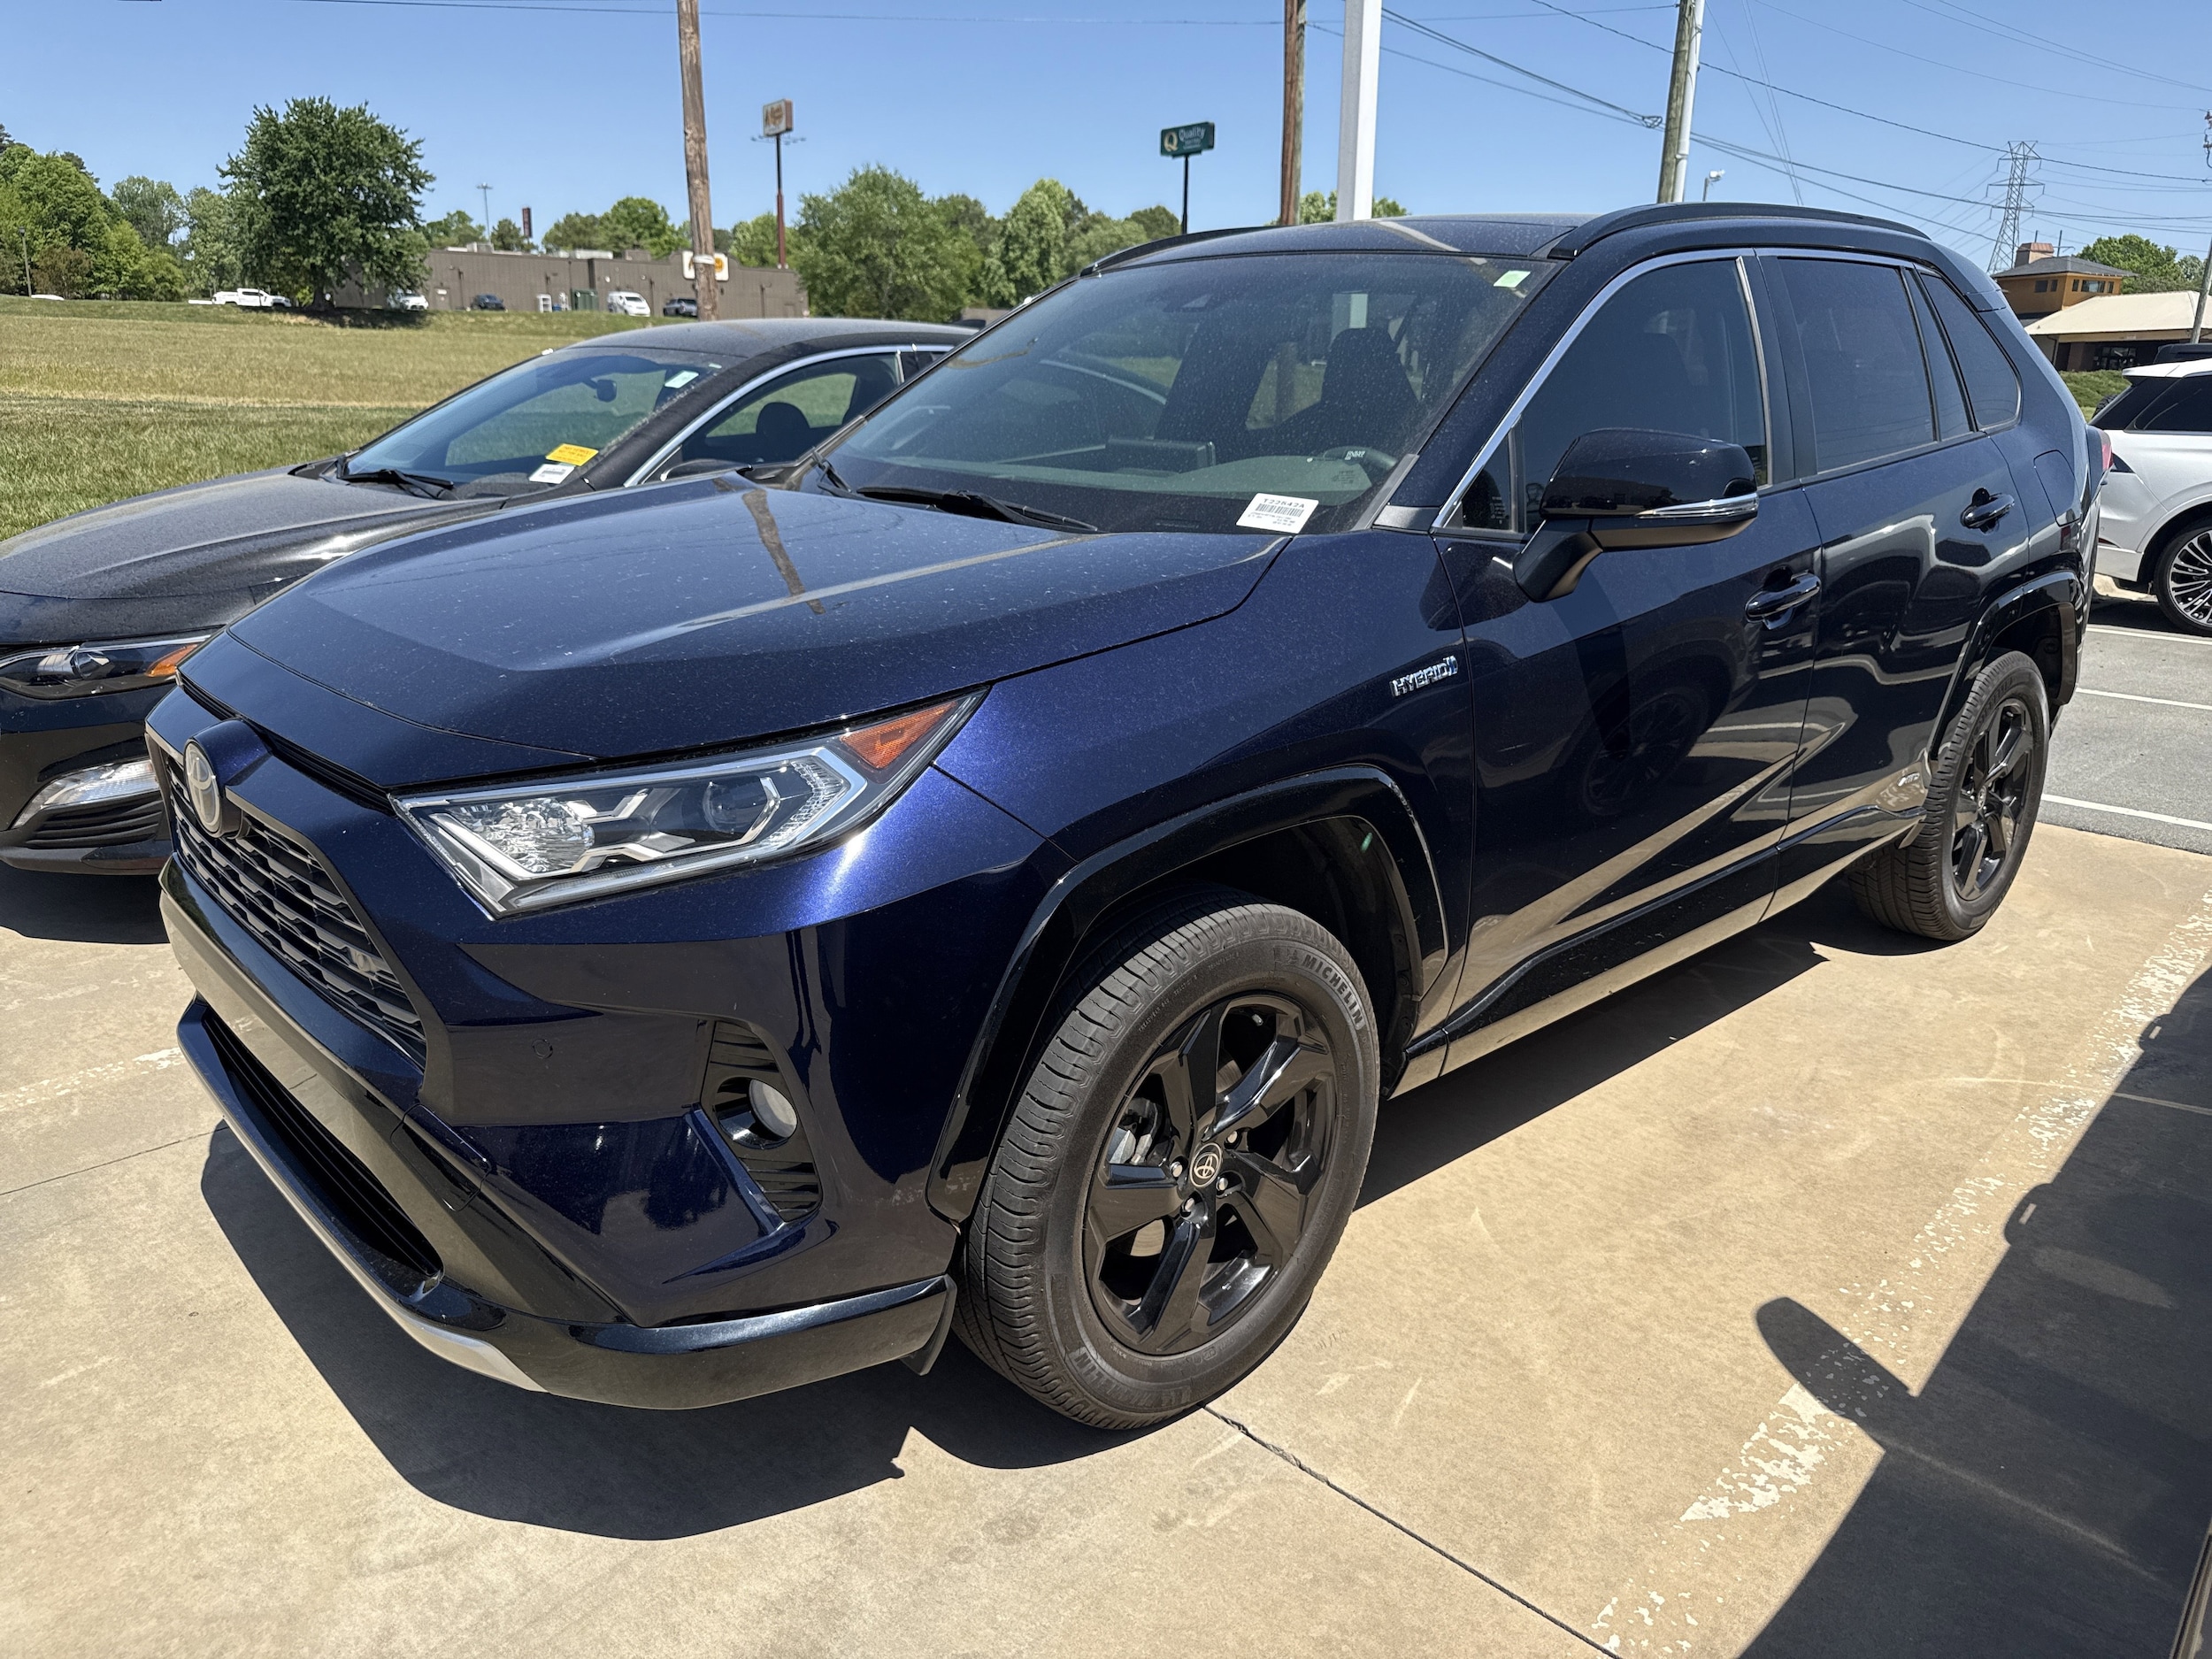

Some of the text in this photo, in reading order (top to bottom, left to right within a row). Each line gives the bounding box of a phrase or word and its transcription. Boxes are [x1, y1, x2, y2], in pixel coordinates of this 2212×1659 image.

[1179, 127, 1205, 142] Quality
[1390, 663, 1448, 696] HYBRID
[1302, 954, 1363, 1025] MICHELIN
